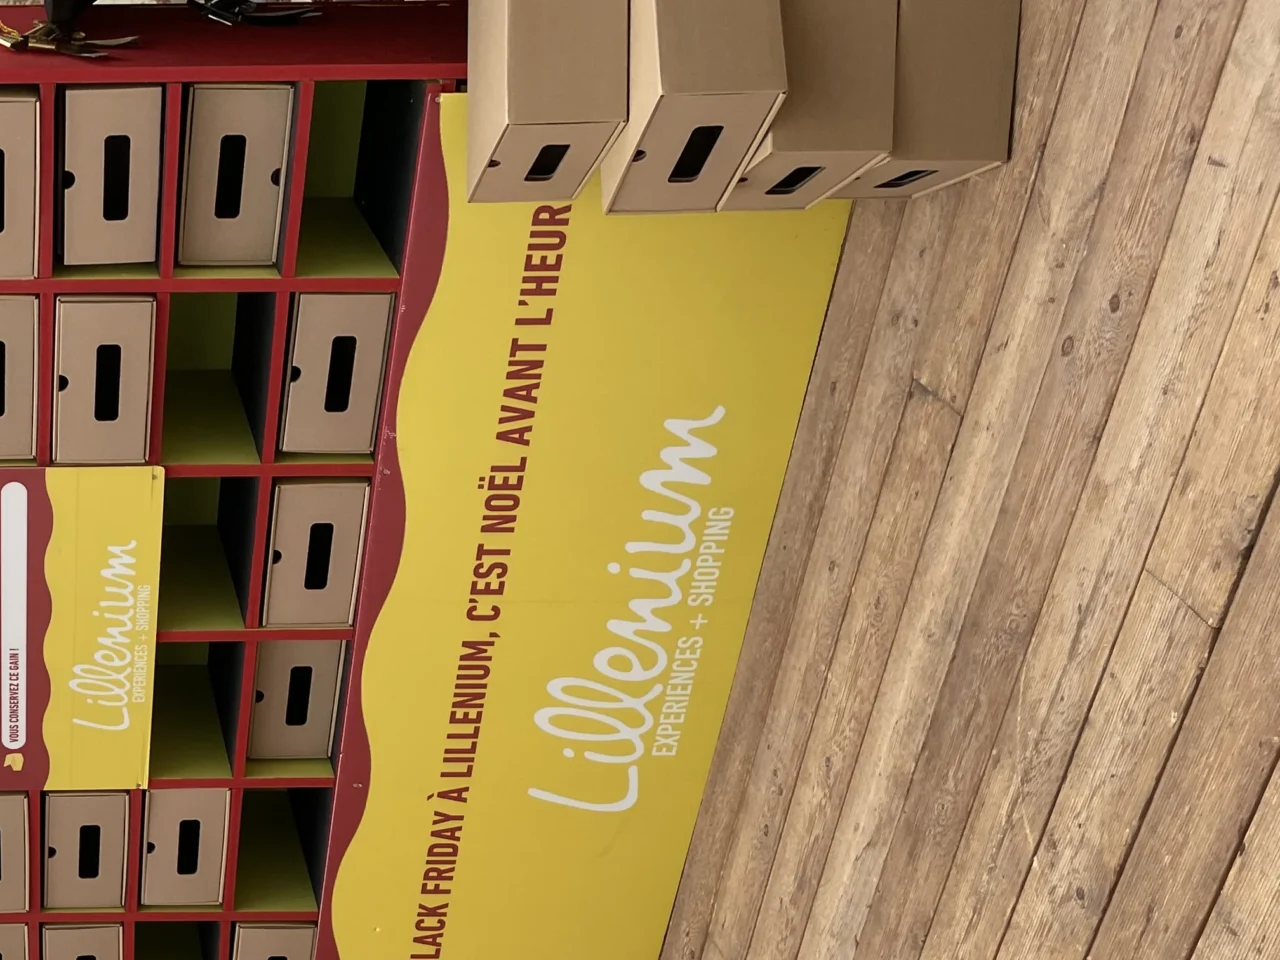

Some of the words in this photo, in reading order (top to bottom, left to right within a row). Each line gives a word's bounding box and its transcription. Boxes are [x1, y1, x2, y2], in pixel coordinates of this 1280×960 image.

[515, 204, 572, 327] L'HEUR
[495, 338, 548, 447] AVANT
[476, 456, 528, 534] NOËL
[136, 584, 151, 632] SHOPPING
[464, 545, 512, 622] C'EST
[526, 405, 726, 813] Lillenium
[9, 653, 19, 670] GAIN
[68, 540, 137, 731] Lillenium
[650, 636, 706, 757] EXPERIENCES
[687, 506, 735, 607] SHOPPING
[9, 672, 19, 681] CE
[9, 683, 19, 723] CONSERVEZ
[132, 644, 148, 702] EXPERIENCES
[438, 631, 502, 778] LILLENIUM,
[9, 724, 20, 743] VOUS
[426, 786, 470, 803] À
[417, 810, 466, 895] FRIDAY
